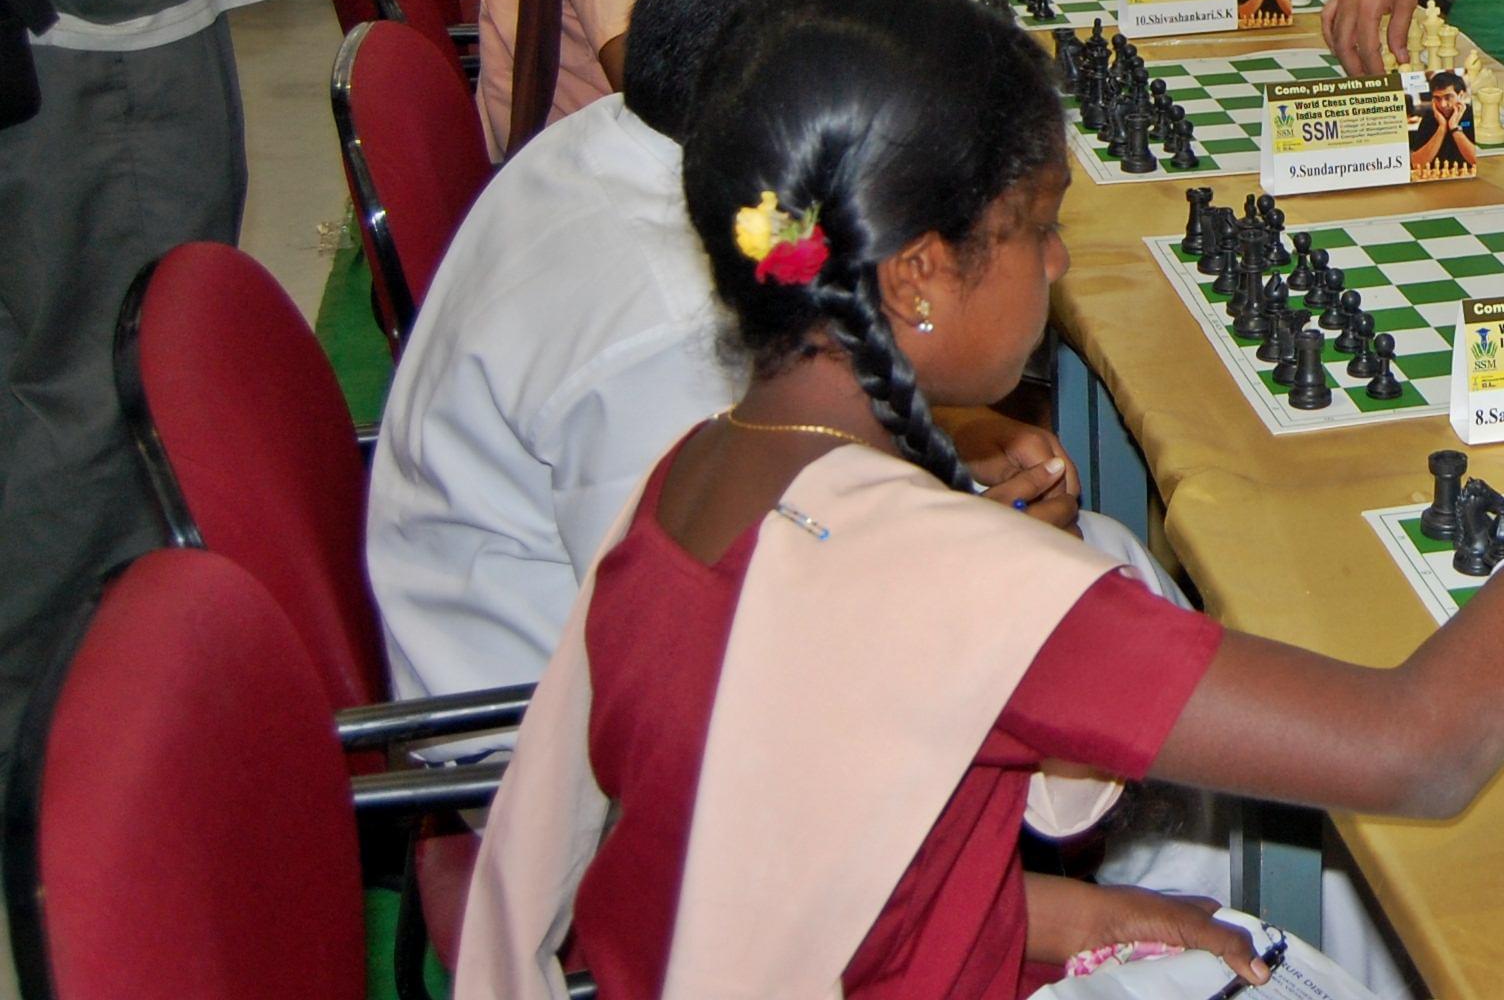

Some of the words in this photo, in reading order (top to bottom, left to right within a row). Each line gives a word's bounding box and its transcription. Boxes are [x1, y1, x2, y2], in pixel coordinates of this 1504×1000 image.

[1312, 83, 1335, 94] play
[1338, 80, 1362, 90] with
[1295, 101, 1319, 110] World
[1322, 98, 1347, 107] Chess
[1349, 95, 1391, 107] Champion
[1296, 111, 1322, 121] Indian
[1325, 108, 1349, 118] Chess
[1352, 104, 1404, 115] Grandmaster
[1302, 120, 1339, 142] SSM
[1474, 359, 1496, 370] SSM
